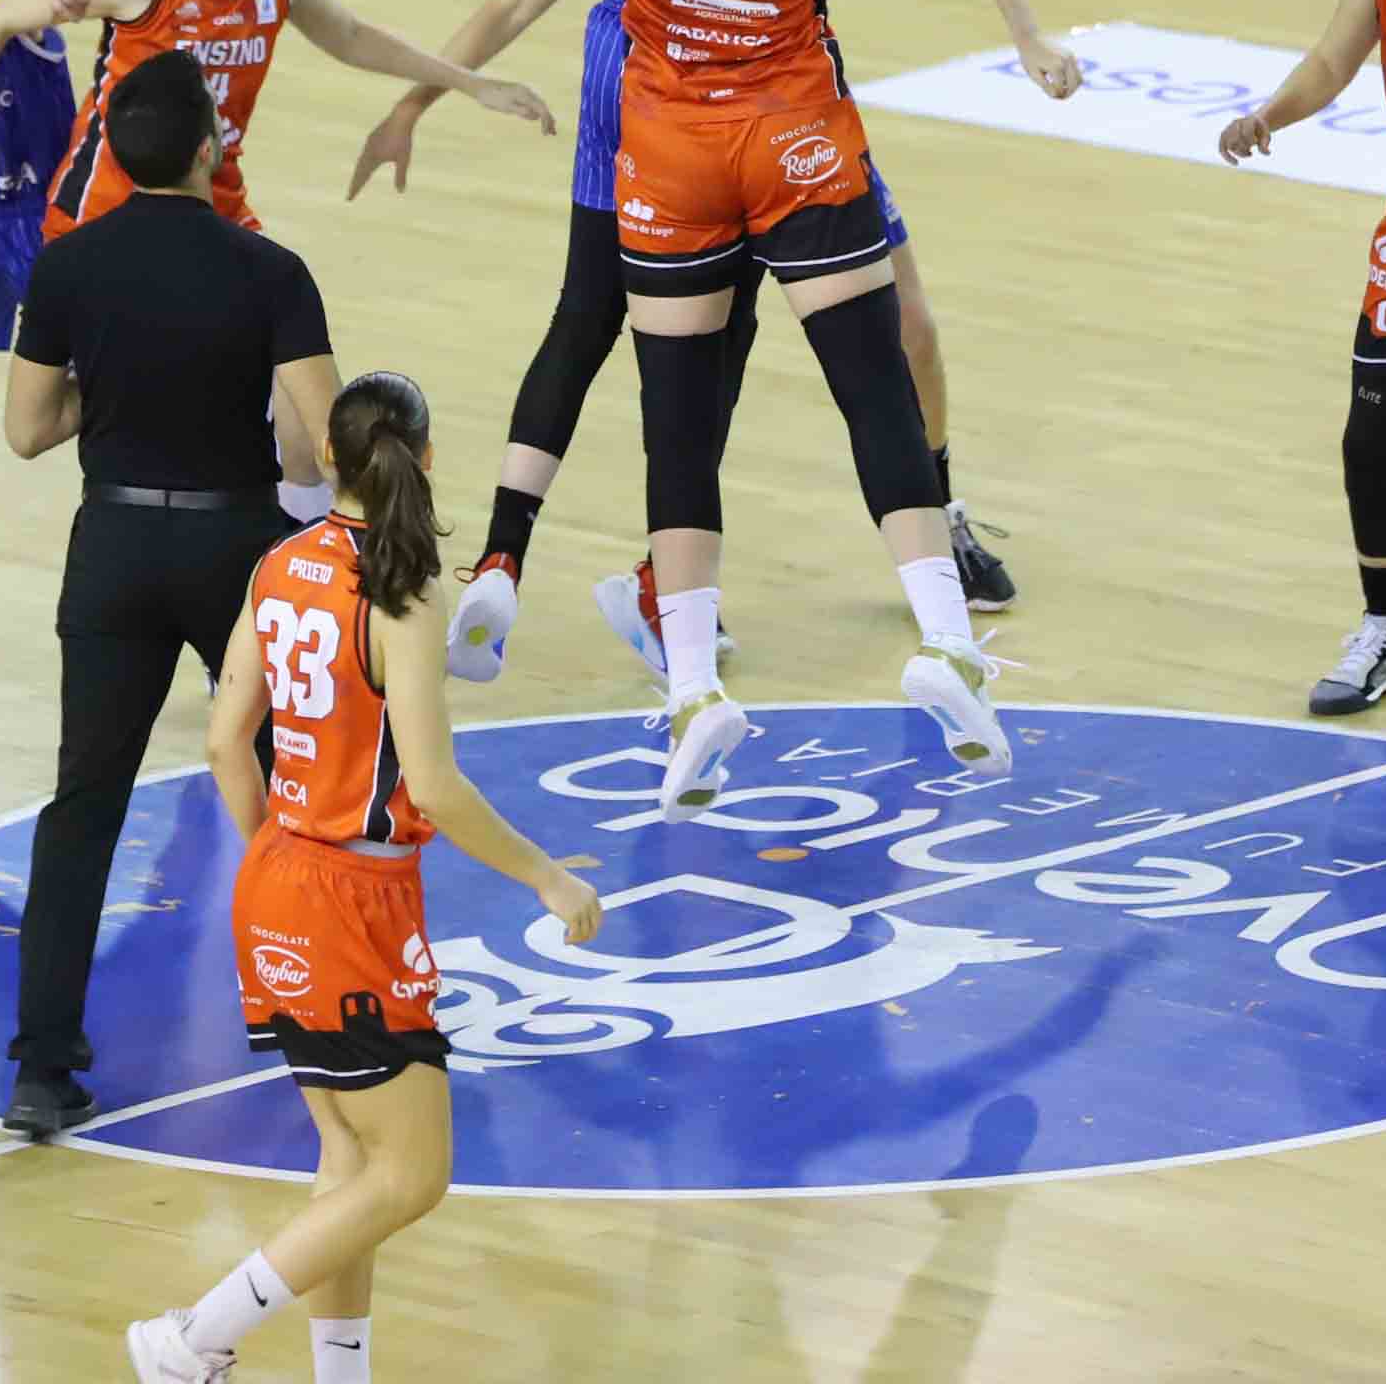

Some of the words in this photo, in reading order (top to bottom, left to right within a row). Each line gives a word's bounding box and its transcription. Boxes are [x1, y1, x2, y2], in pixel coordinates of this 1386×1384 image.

[783, 143, 838, 179] Reybar
[256, 597, 341, 719] 33
[250, 924, 311, 947] CHOCOLATE
[254, 950, 310, 985] Reybar
